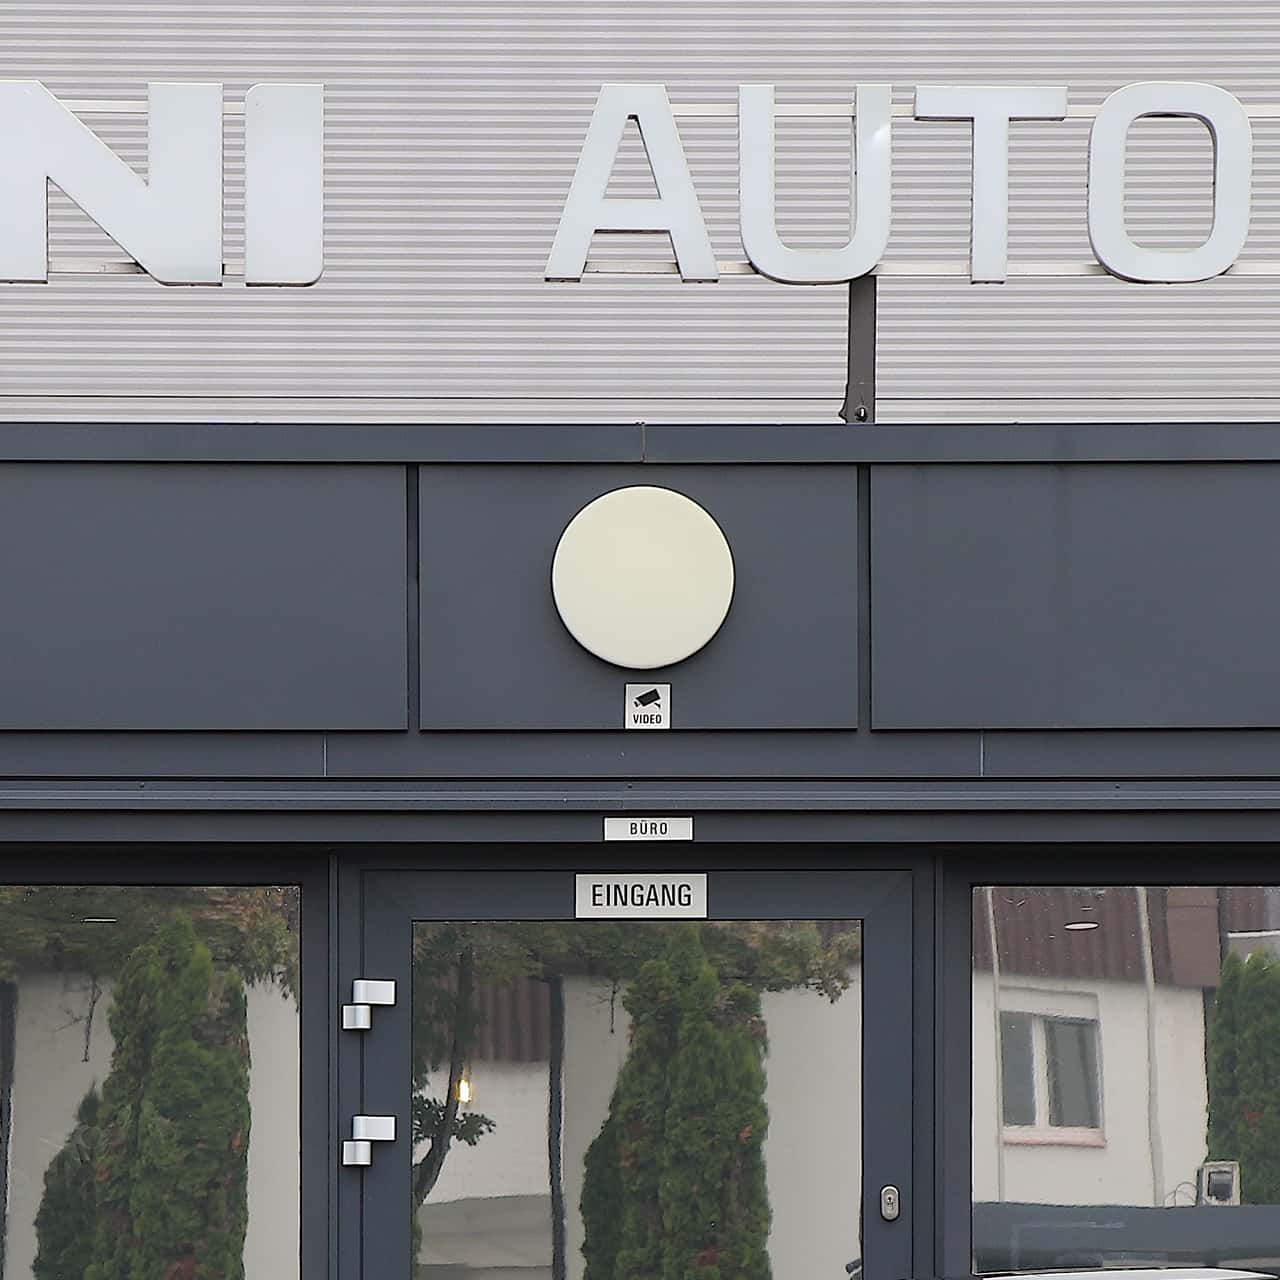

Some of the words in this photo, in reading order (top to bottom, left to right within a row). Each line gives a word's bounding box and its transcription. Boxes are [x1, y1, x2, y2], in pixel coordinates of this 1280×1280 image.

[543, 79, 1254, 284] AUTO
[632, 713, 663, 725] VIDEO
[629, 819, 669, 836] BÜRO
[591, 883, 693, 907] EINGANG
